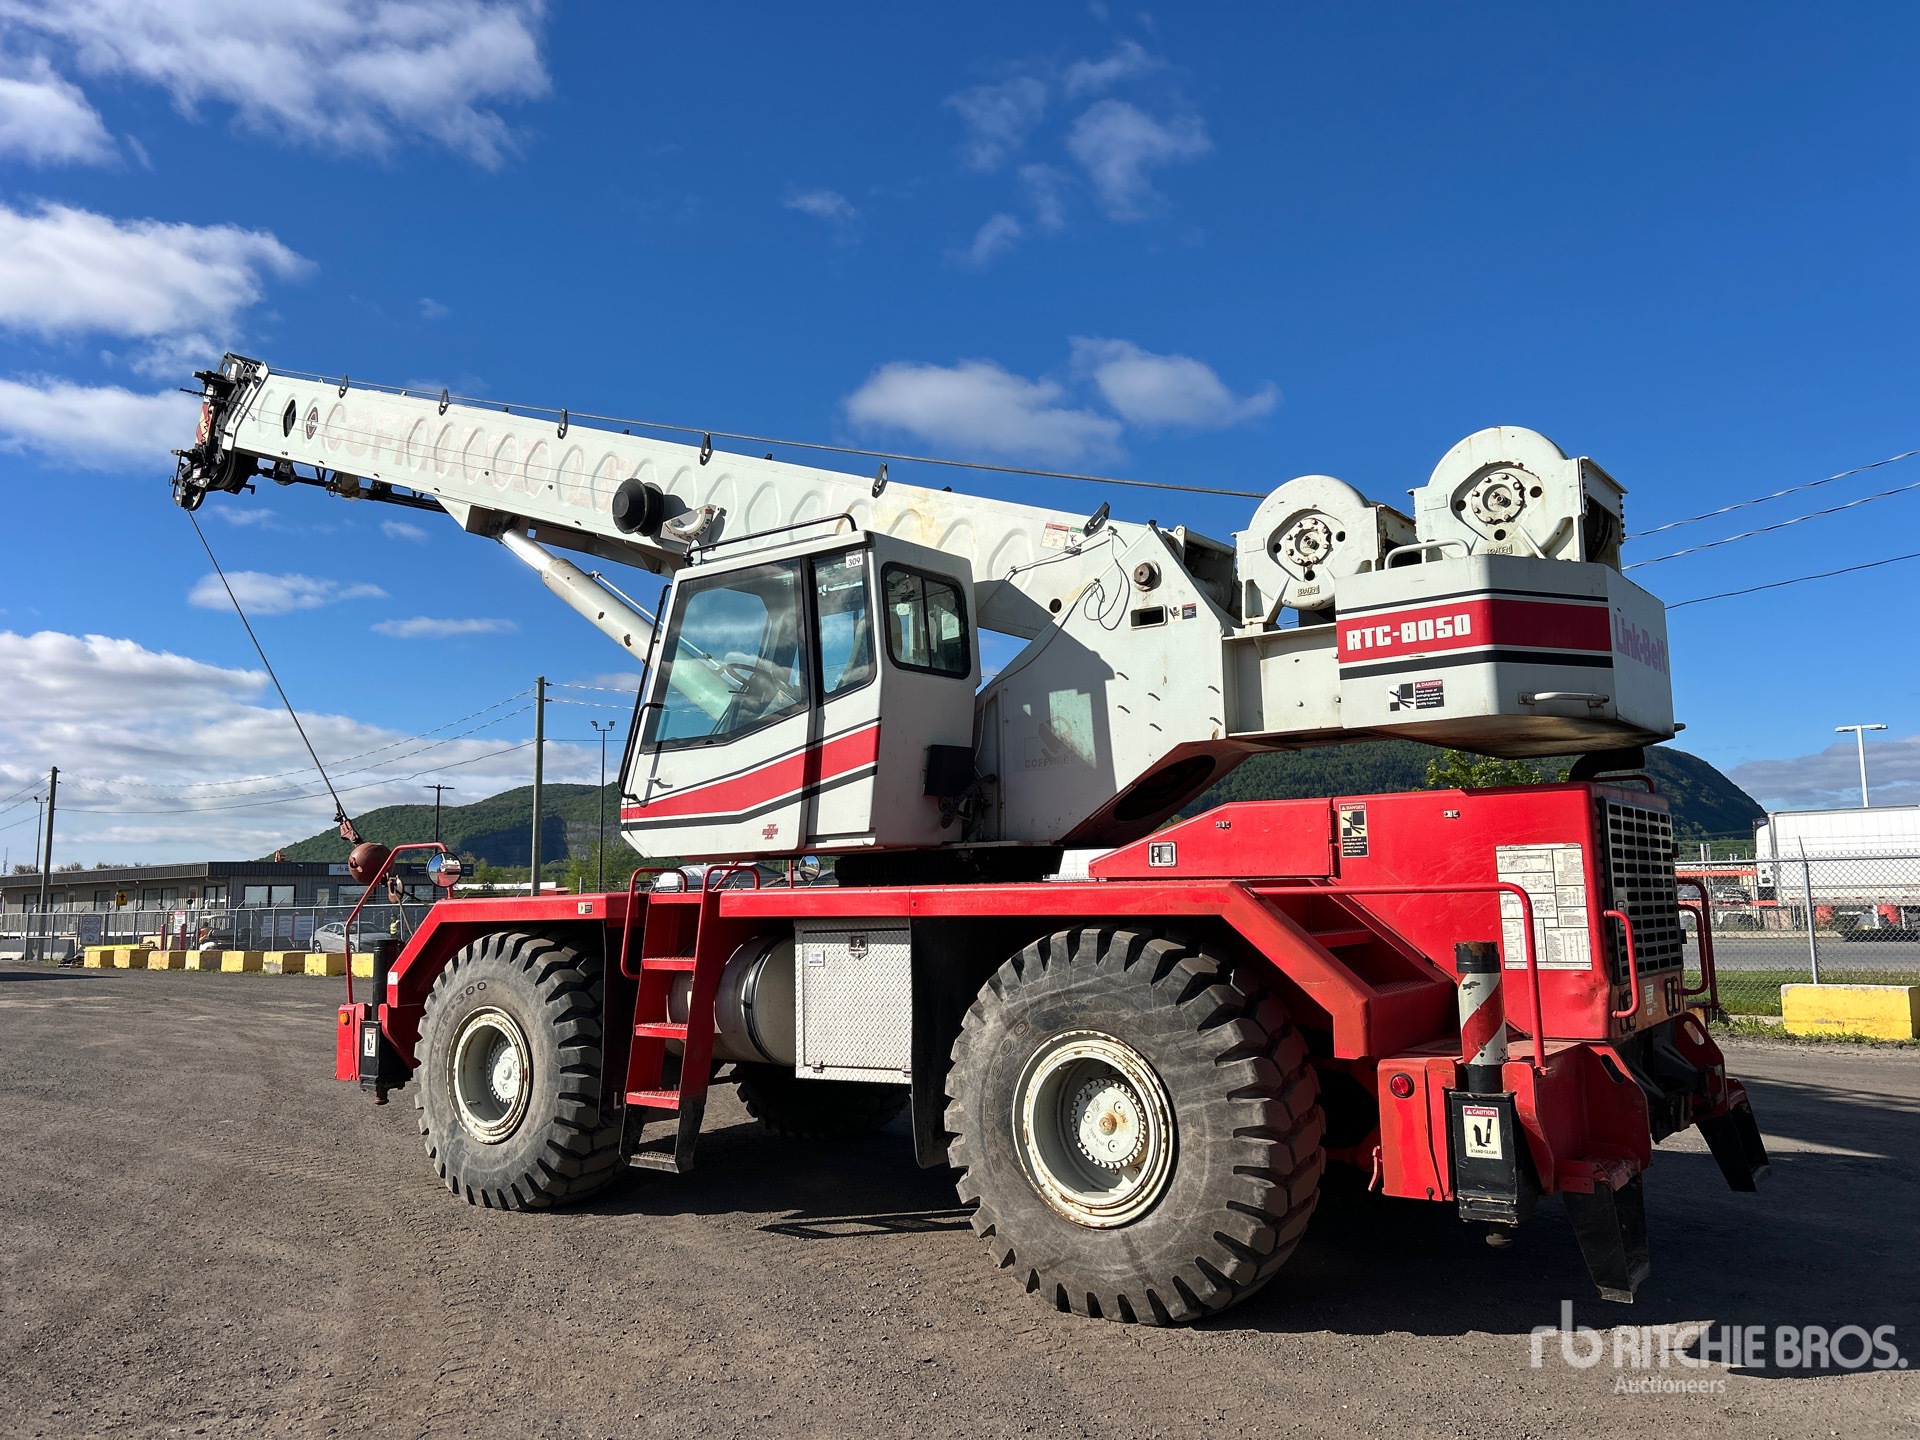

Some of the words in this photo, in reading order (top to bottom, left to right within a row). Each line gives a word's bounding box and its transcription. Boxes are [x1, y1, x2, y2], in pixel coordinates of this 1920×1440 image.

[848, 557, 861, 567] 309
[1346, 613, 1471, 651] RTC-8050
[1614, 613, 1667, 675] Link-Belt
